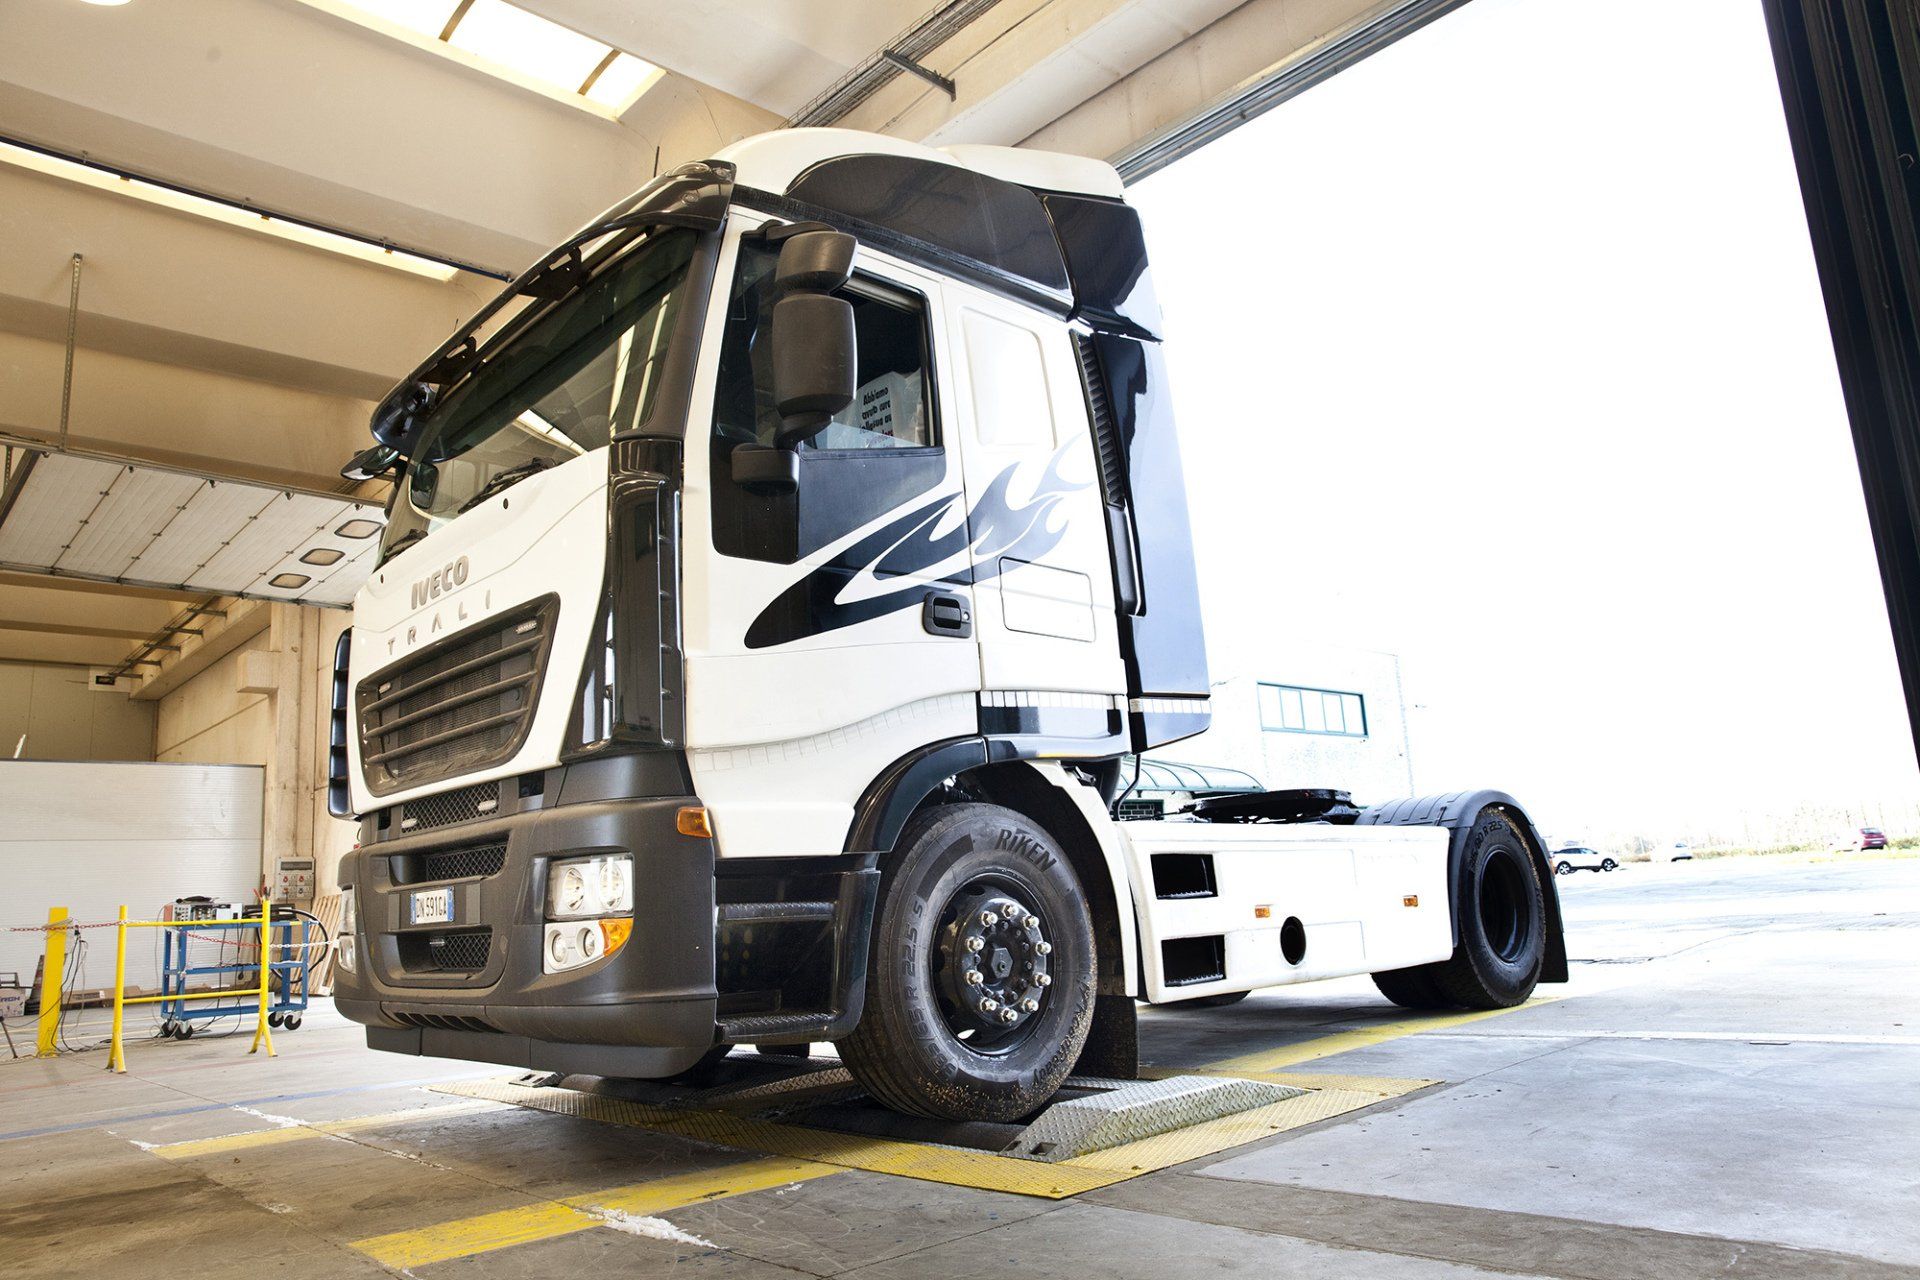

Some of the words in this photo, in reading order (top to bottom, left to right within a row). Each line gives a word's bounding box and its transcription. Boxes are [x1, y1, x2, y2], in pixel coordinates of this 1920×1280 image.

[863, 387, 888, 405] Abbiamo
[411, 555, 470, 610] IVECO
[387, 589, 491, 655] TRALI
[994, 828, 1057, 872] RIKEN
